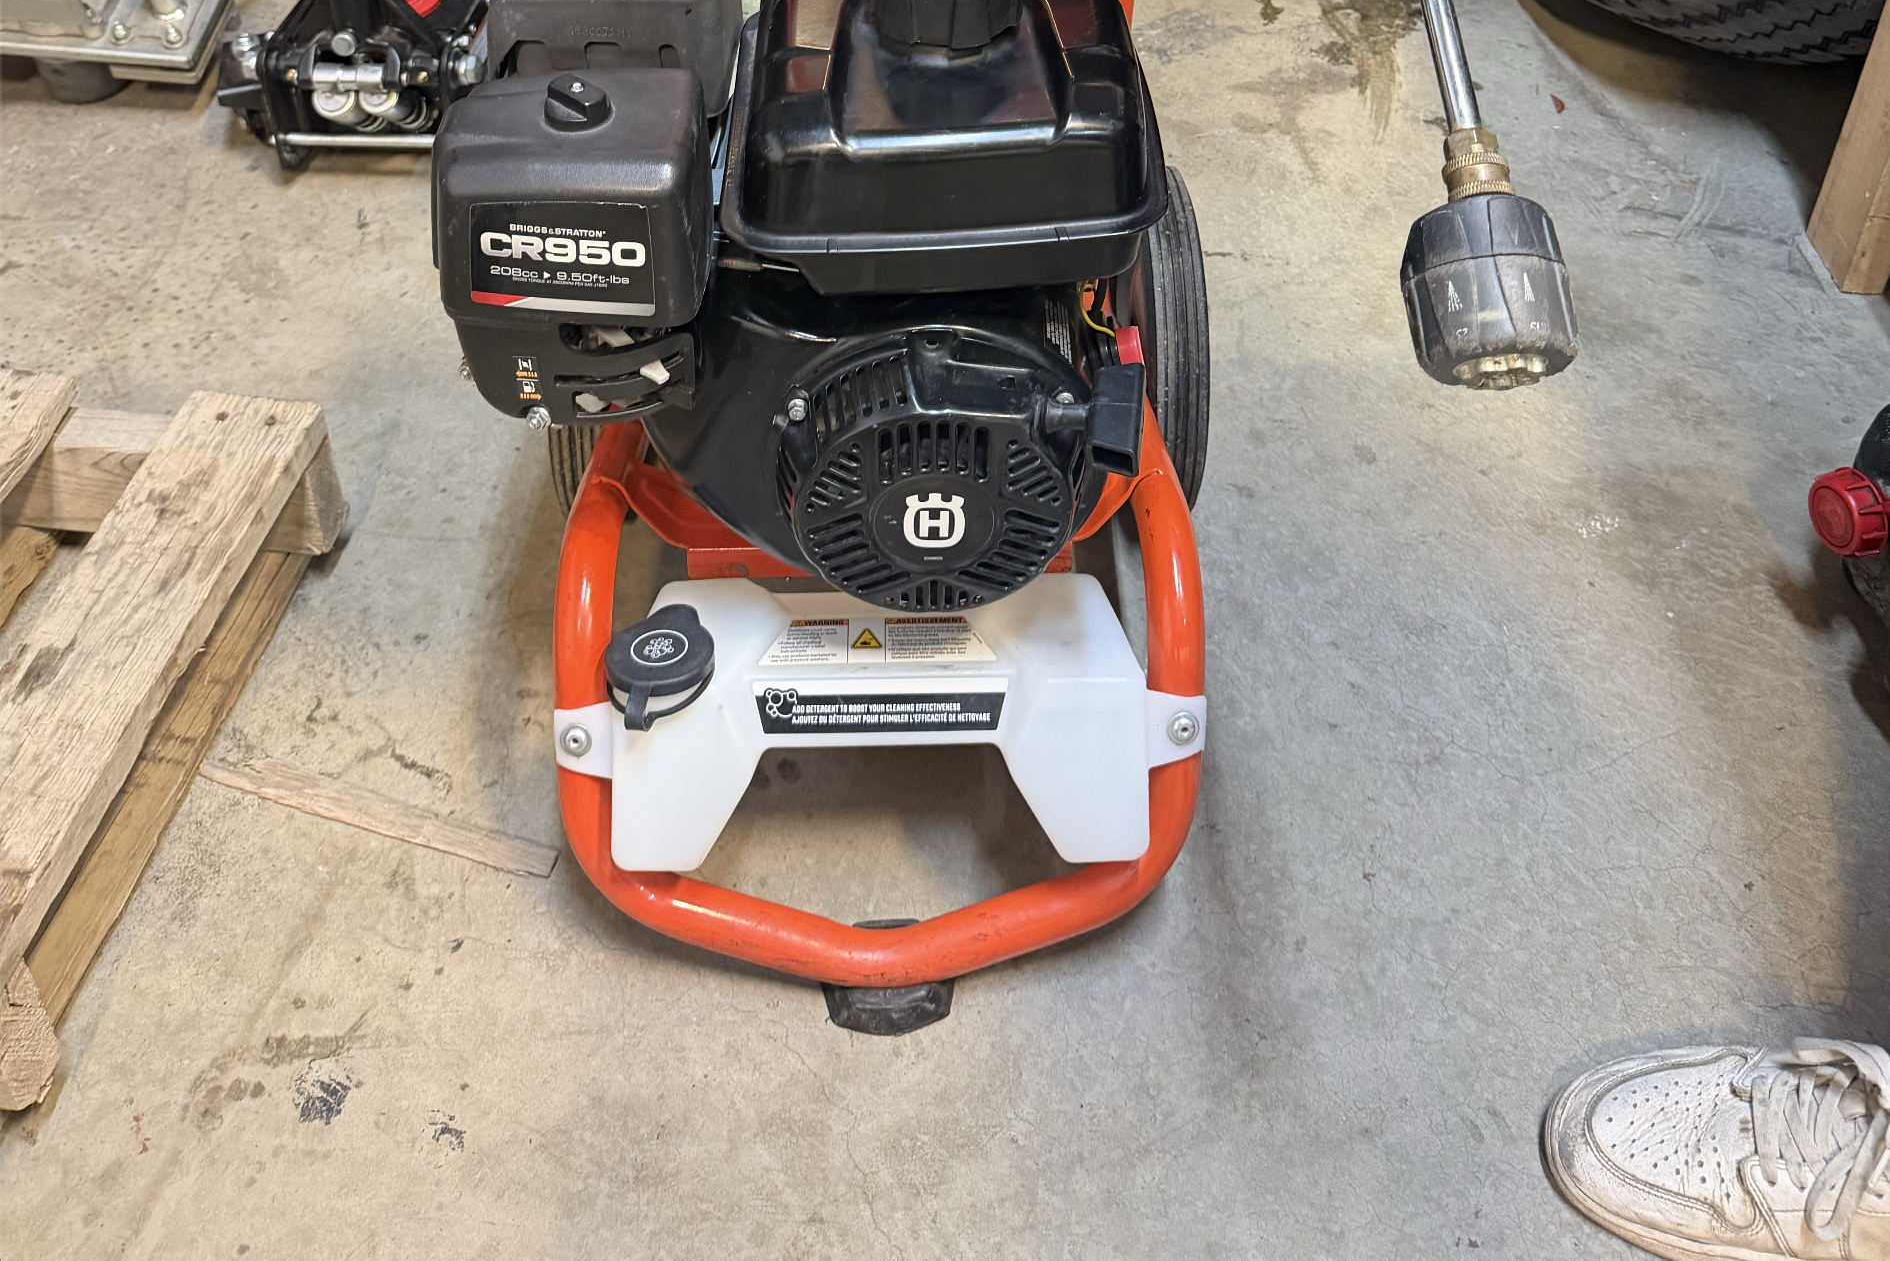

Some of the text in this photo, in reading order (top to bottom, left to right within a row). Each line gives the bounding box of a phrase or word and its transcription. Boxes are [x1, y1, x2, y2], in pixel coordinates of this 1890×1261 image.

[480, 231, 646, 267] CR950
[490, 265, 630, 284] 208cc 9.50ft-lbs
[792, 703, 961, 713] ADD DETERGENT TO BOOST YOUR CLEANING EFFECTIVENESS
[792, 715, 818, 724] AJOUTEZ
[819, 715, 827, 724] DU
[863, 714, 878, 724] POUR
[880, 714, 909, 723] STIMULER
[949, 713, 956, 722] DE
[957, 713, 991, 722] NETTOYAGE
